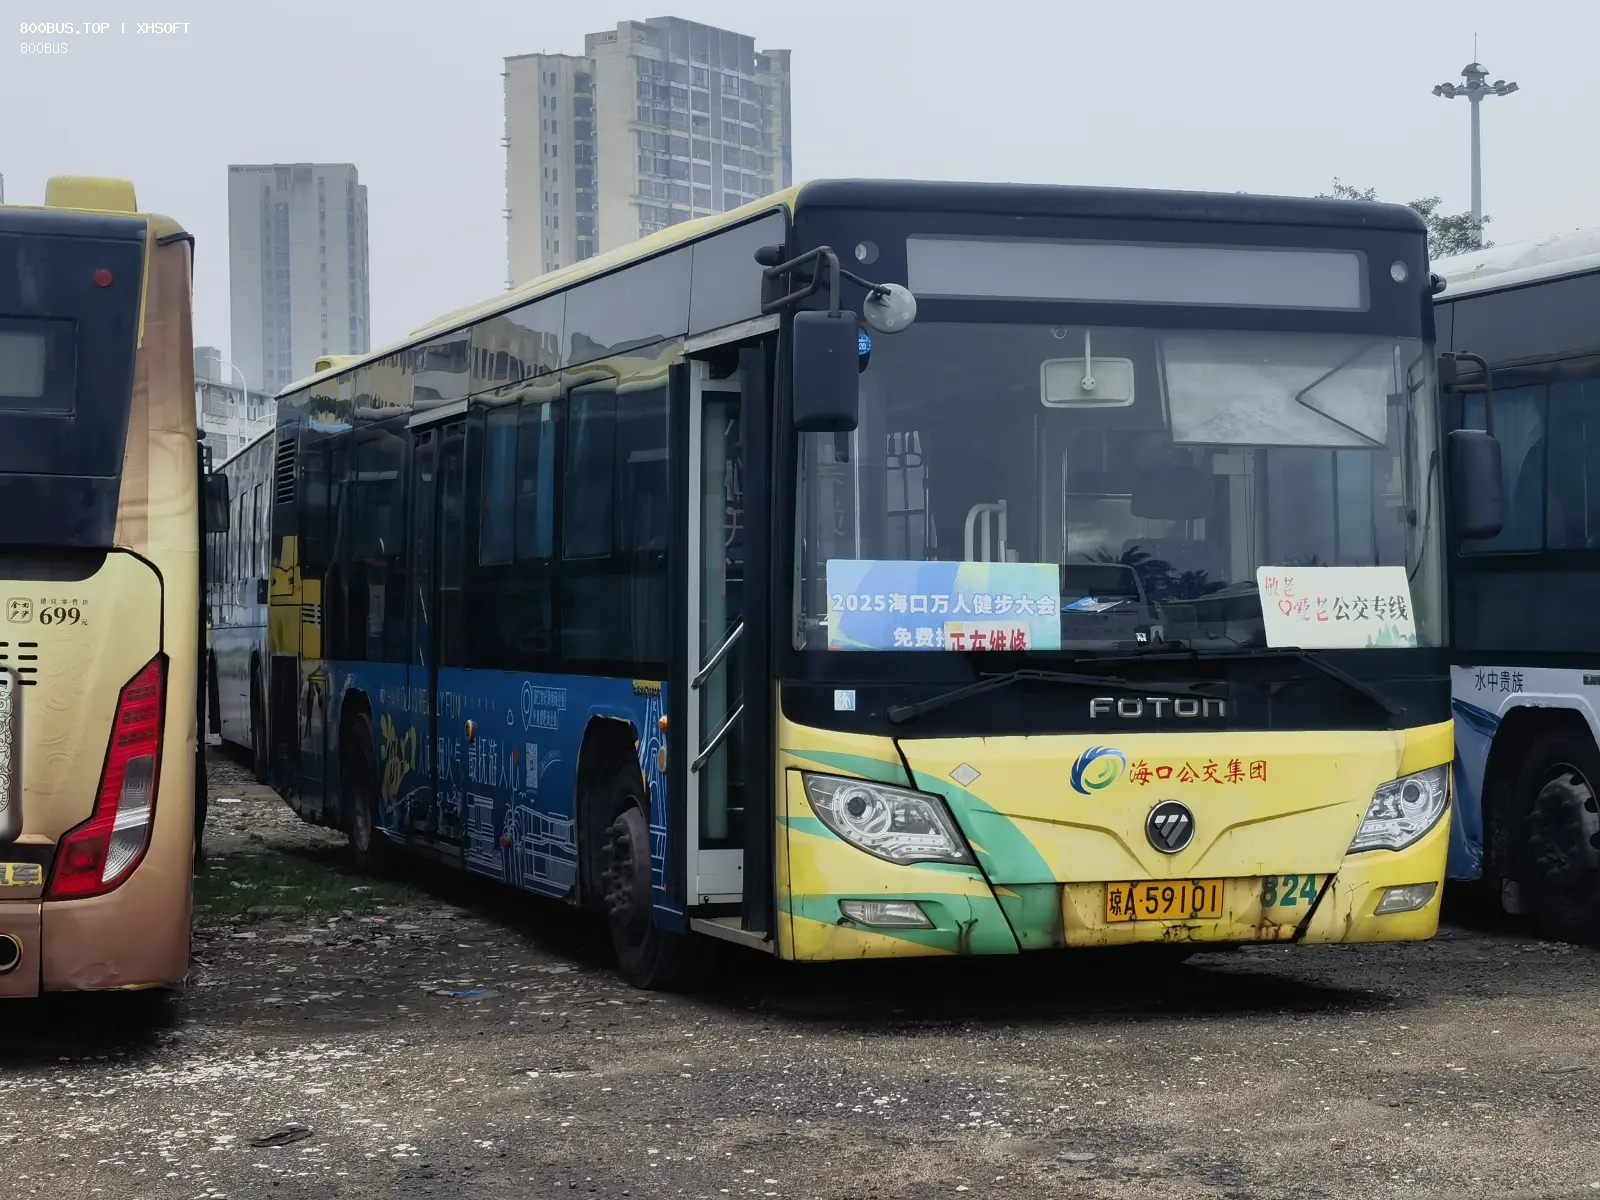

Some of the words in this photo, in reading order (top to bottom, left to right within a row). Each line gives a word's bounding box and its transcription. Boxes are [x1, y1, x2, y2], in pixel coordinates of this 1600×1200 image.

[831, 592, 1057, 616] 2025海口万人健步大会
[949, 628, 1028, 650] 正在维修
[1475, 669, 1523, 693] 水中贵族
[1089, 697, 1226, 718] FOTON
[1129, 758, 1268, 786] 海口公交集团
[1260, 874, 1318, 908] 824
